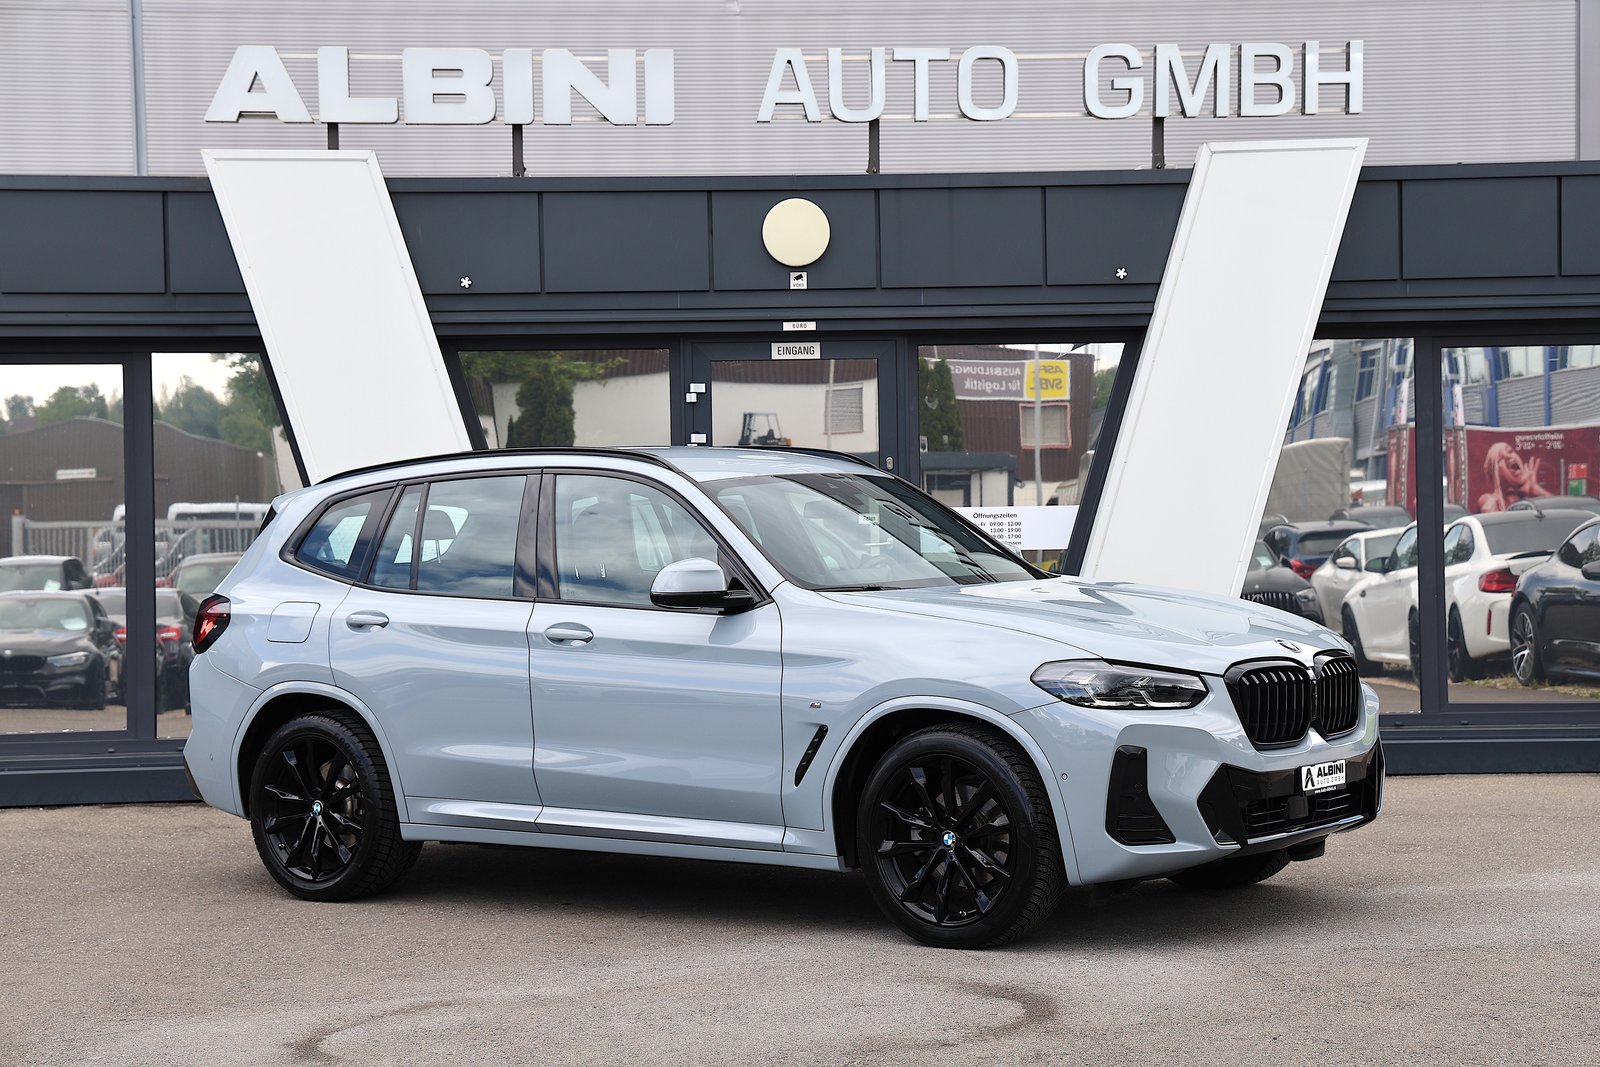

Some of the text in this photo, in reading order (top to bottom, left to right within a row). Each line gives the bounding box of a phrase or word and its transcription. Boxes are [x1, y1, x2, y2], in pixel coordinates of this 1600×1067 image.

[204, 39, 1364, 126] ALBINI AUTO GMBH
[777, 345, 815, 356] EINGANG
[1317, 763, 1344, 778] ALBINI
